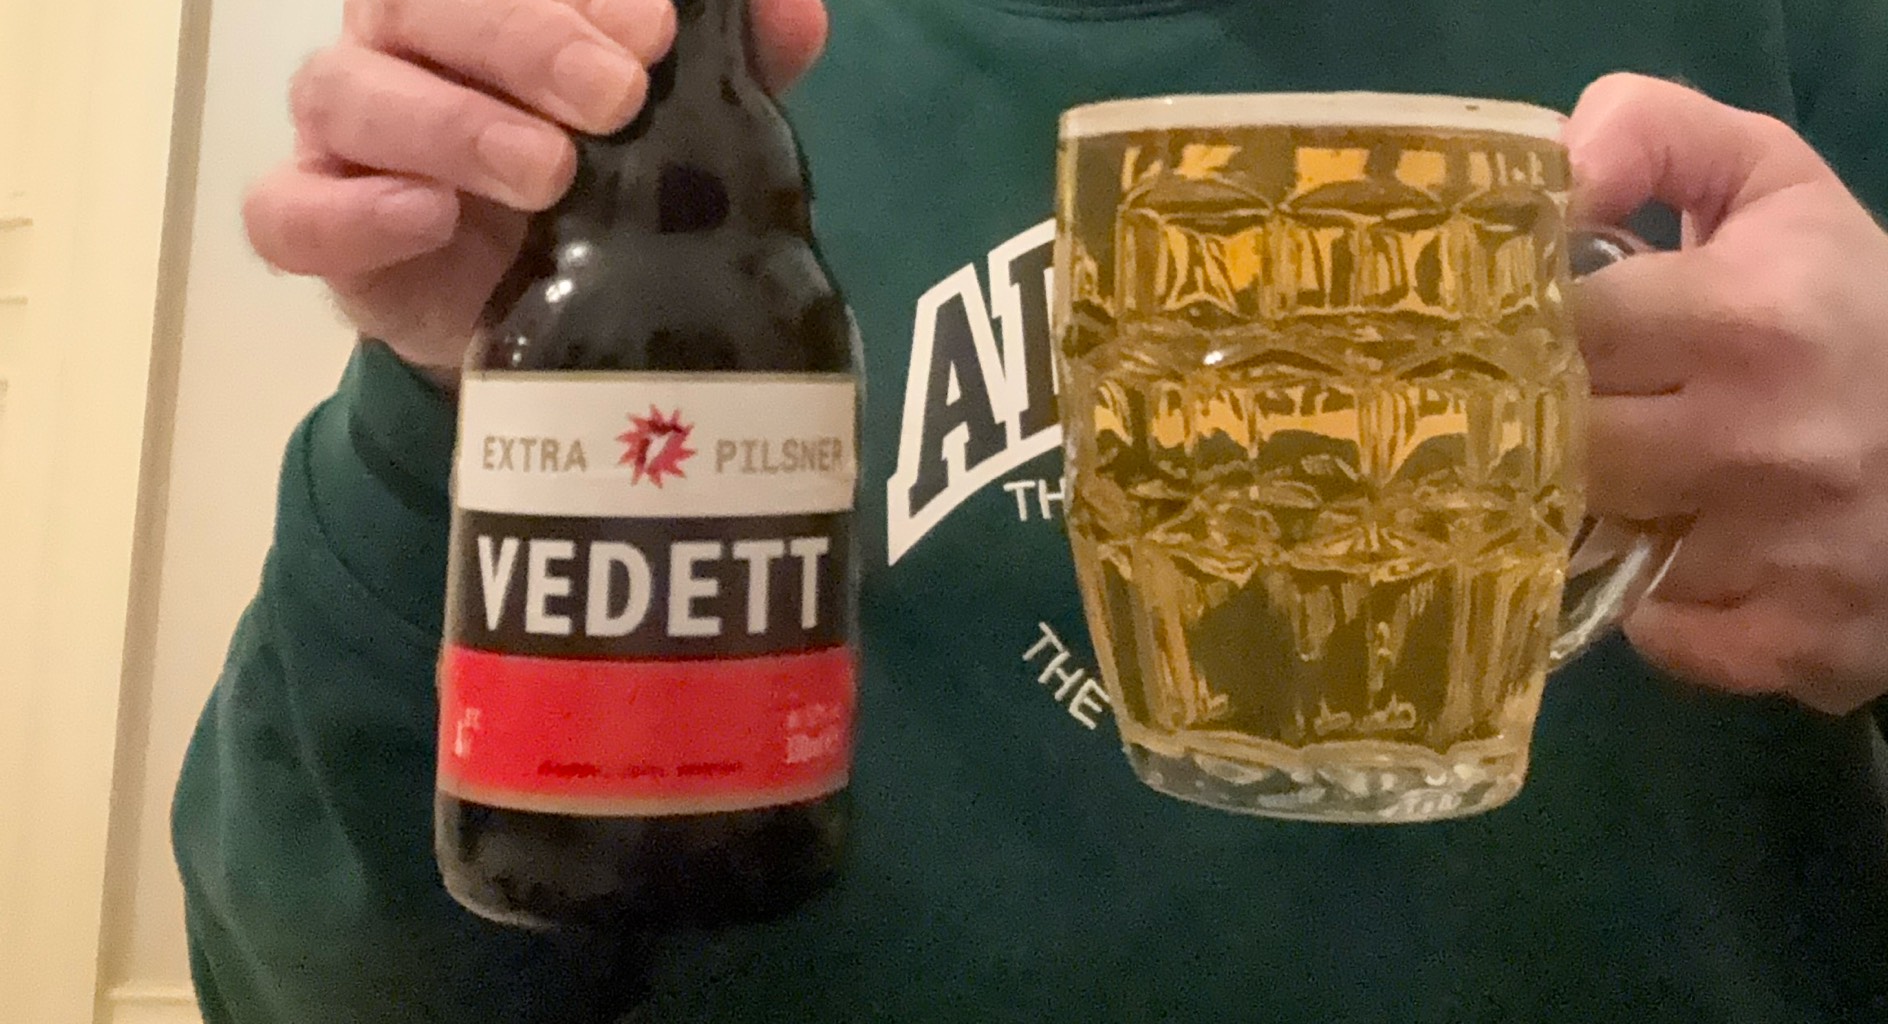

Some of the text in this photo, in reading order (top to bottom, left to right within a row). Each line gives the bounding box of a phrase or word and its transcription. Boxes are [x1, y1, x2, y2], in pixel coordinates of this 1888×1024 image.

[483, 435, 843, 474] EXTRA PILSNER
[477, 533, 830, 638] VEDETT
[1022, 622, 1111, 730] THE
